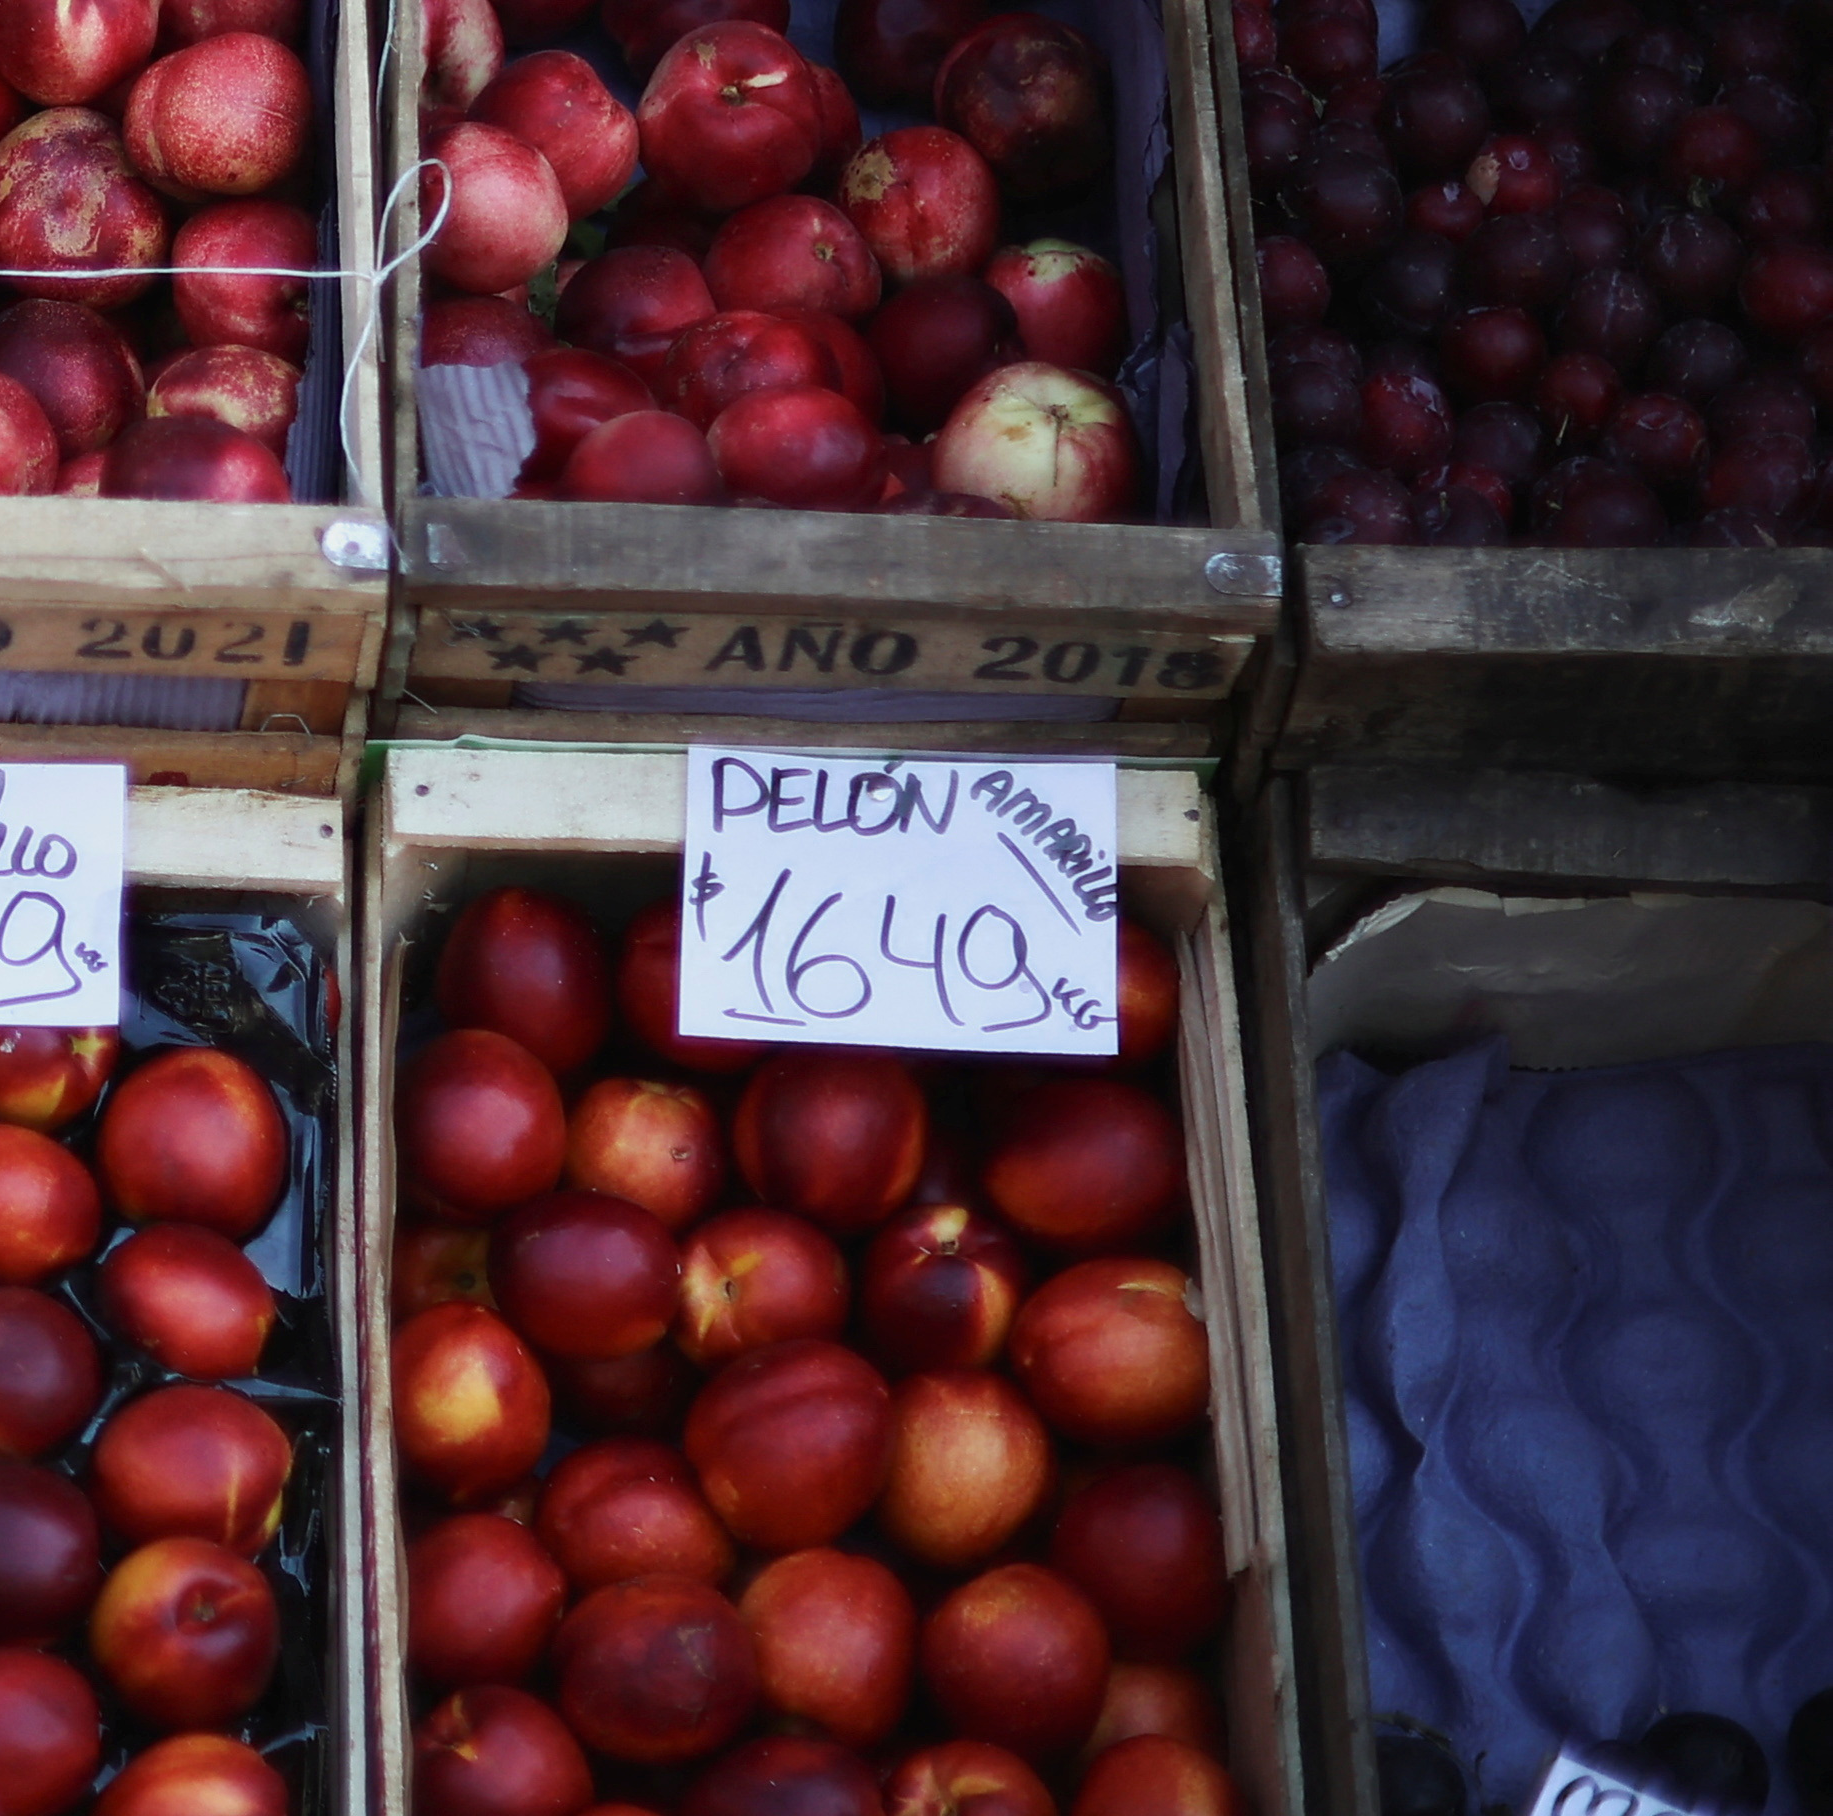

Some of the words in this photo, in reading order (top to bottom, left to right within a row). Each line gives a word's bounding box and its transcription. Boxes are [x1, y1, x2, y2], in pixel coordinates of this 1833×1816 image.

[75, 616, 313, 668] 2021
[704, 622, 920, 678] AÑO
[972, 636, 1229, 691] 2018
[711, 757, 960, 837] PELÓN
[689, 851, 1053, 1034] $1649
